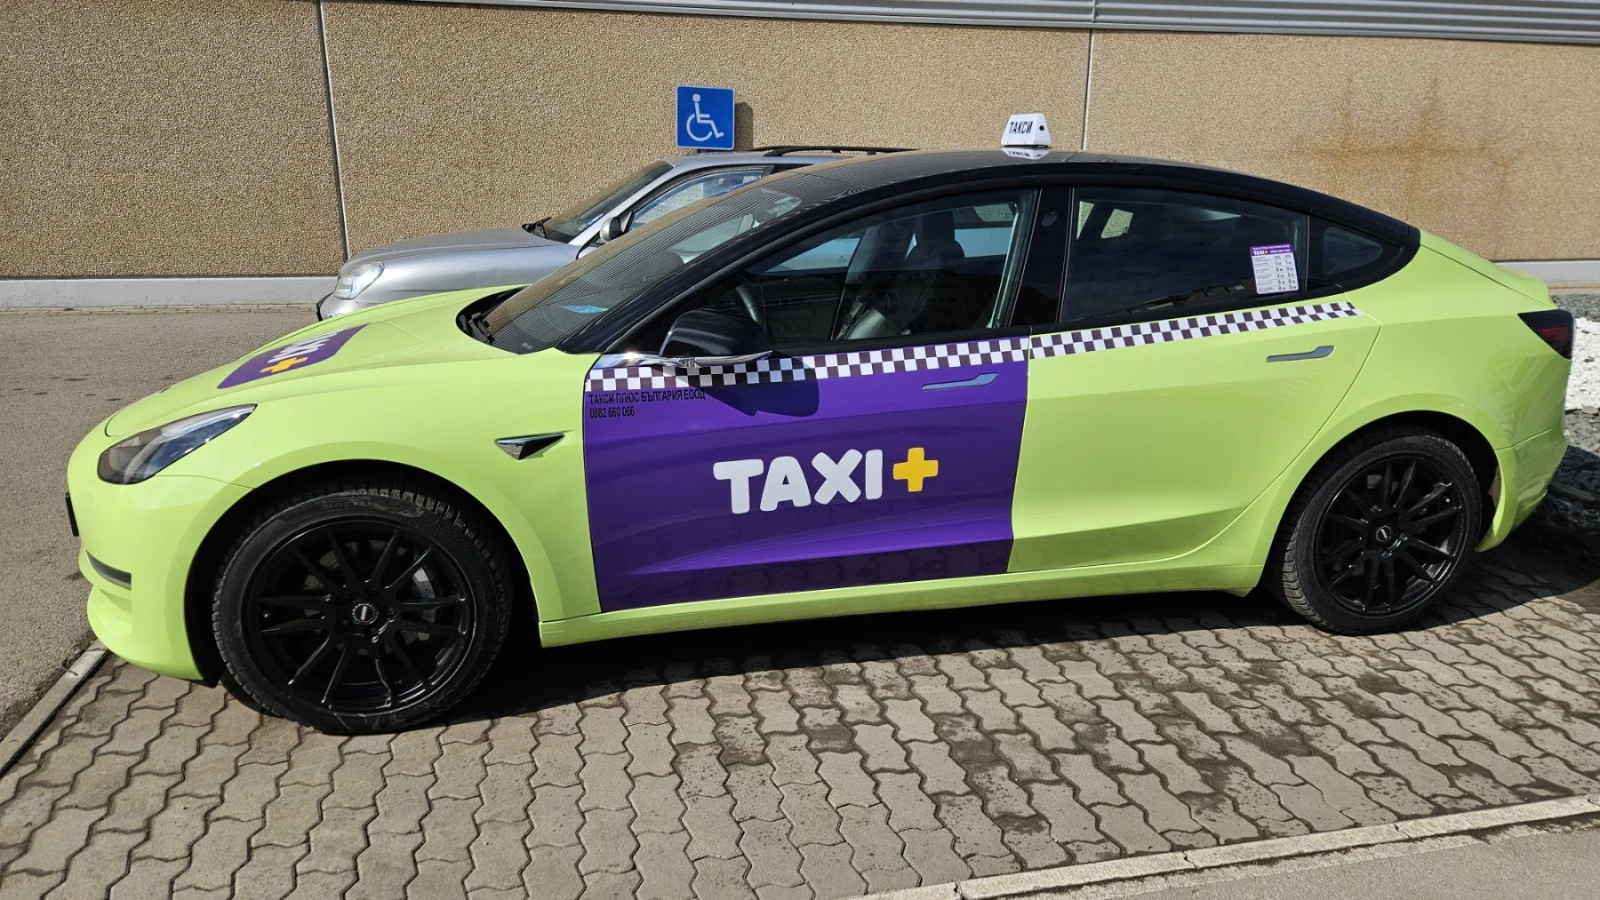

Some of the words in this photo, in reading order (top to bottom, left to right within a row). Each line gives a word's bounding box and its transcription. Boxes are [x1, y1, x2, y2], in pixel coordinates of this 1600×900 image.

[1008, 120, 1033, 134] ТАКСИ
[589, 393, 615, 405] ТАКСИ
[616, 392, 640, 403] ПЛЮС
[641, 389, 683, 402] БЪЛГАРИЯ
[684, 388, 706, 401] ЕООД
